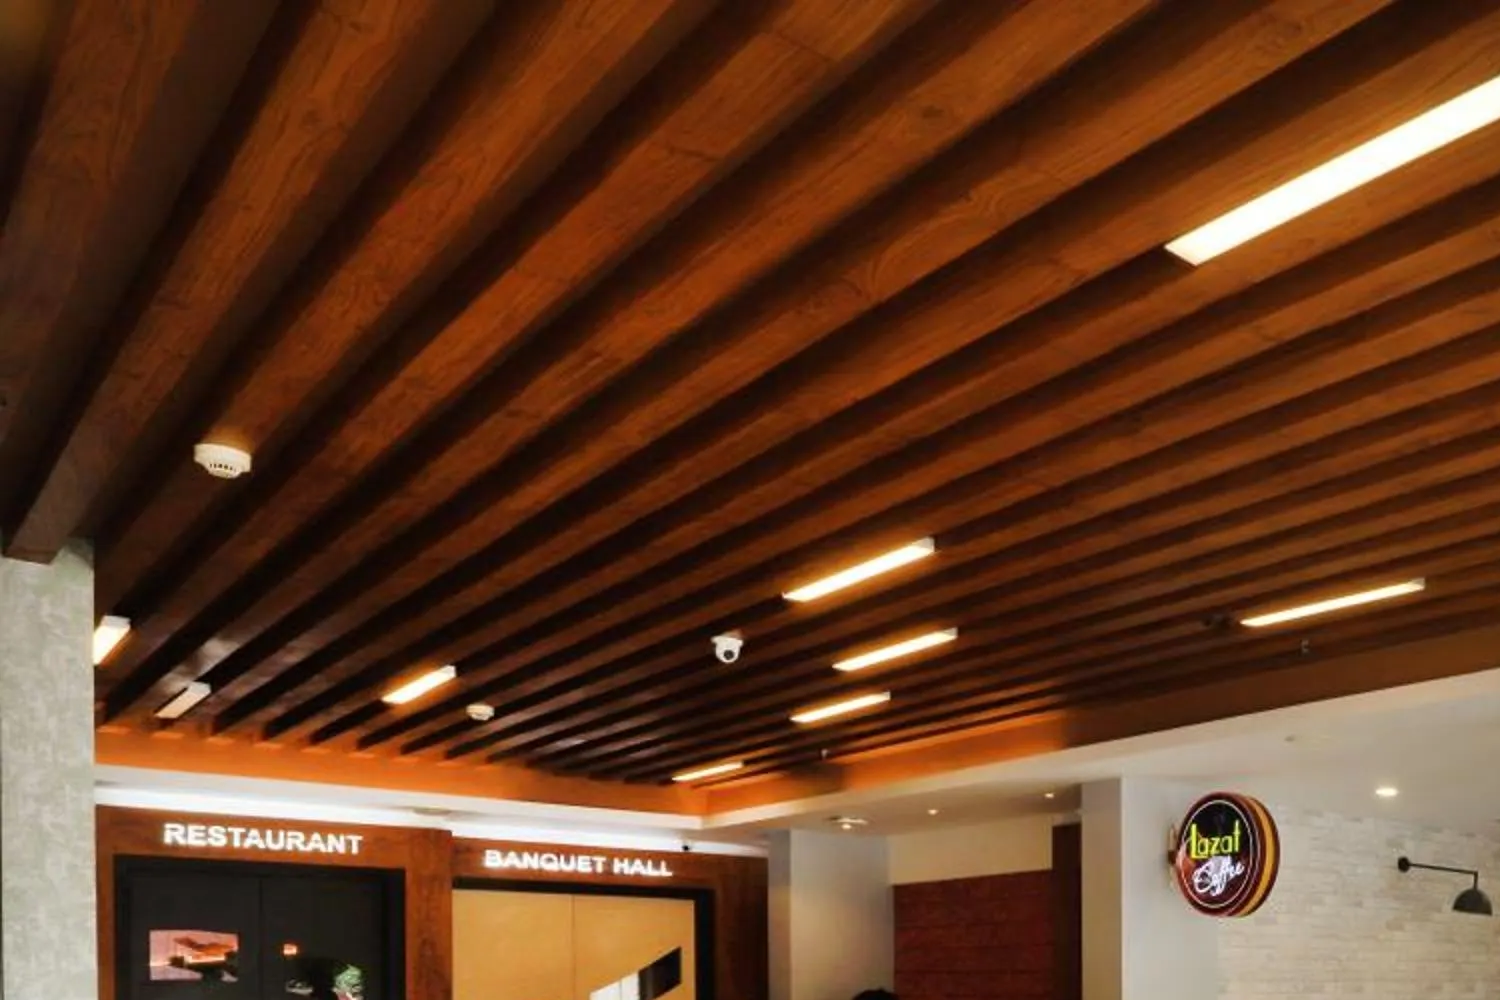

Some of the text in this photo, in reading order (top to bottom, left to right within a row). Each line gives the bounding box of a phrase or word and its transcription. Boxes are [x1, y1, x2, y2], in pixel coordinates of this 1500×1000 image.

[163, 822, 363, 855] RESTAURANT
[1190, 820, 1241, 859] Lazat
[484, 849, 673, 877] BANQUET HALL
